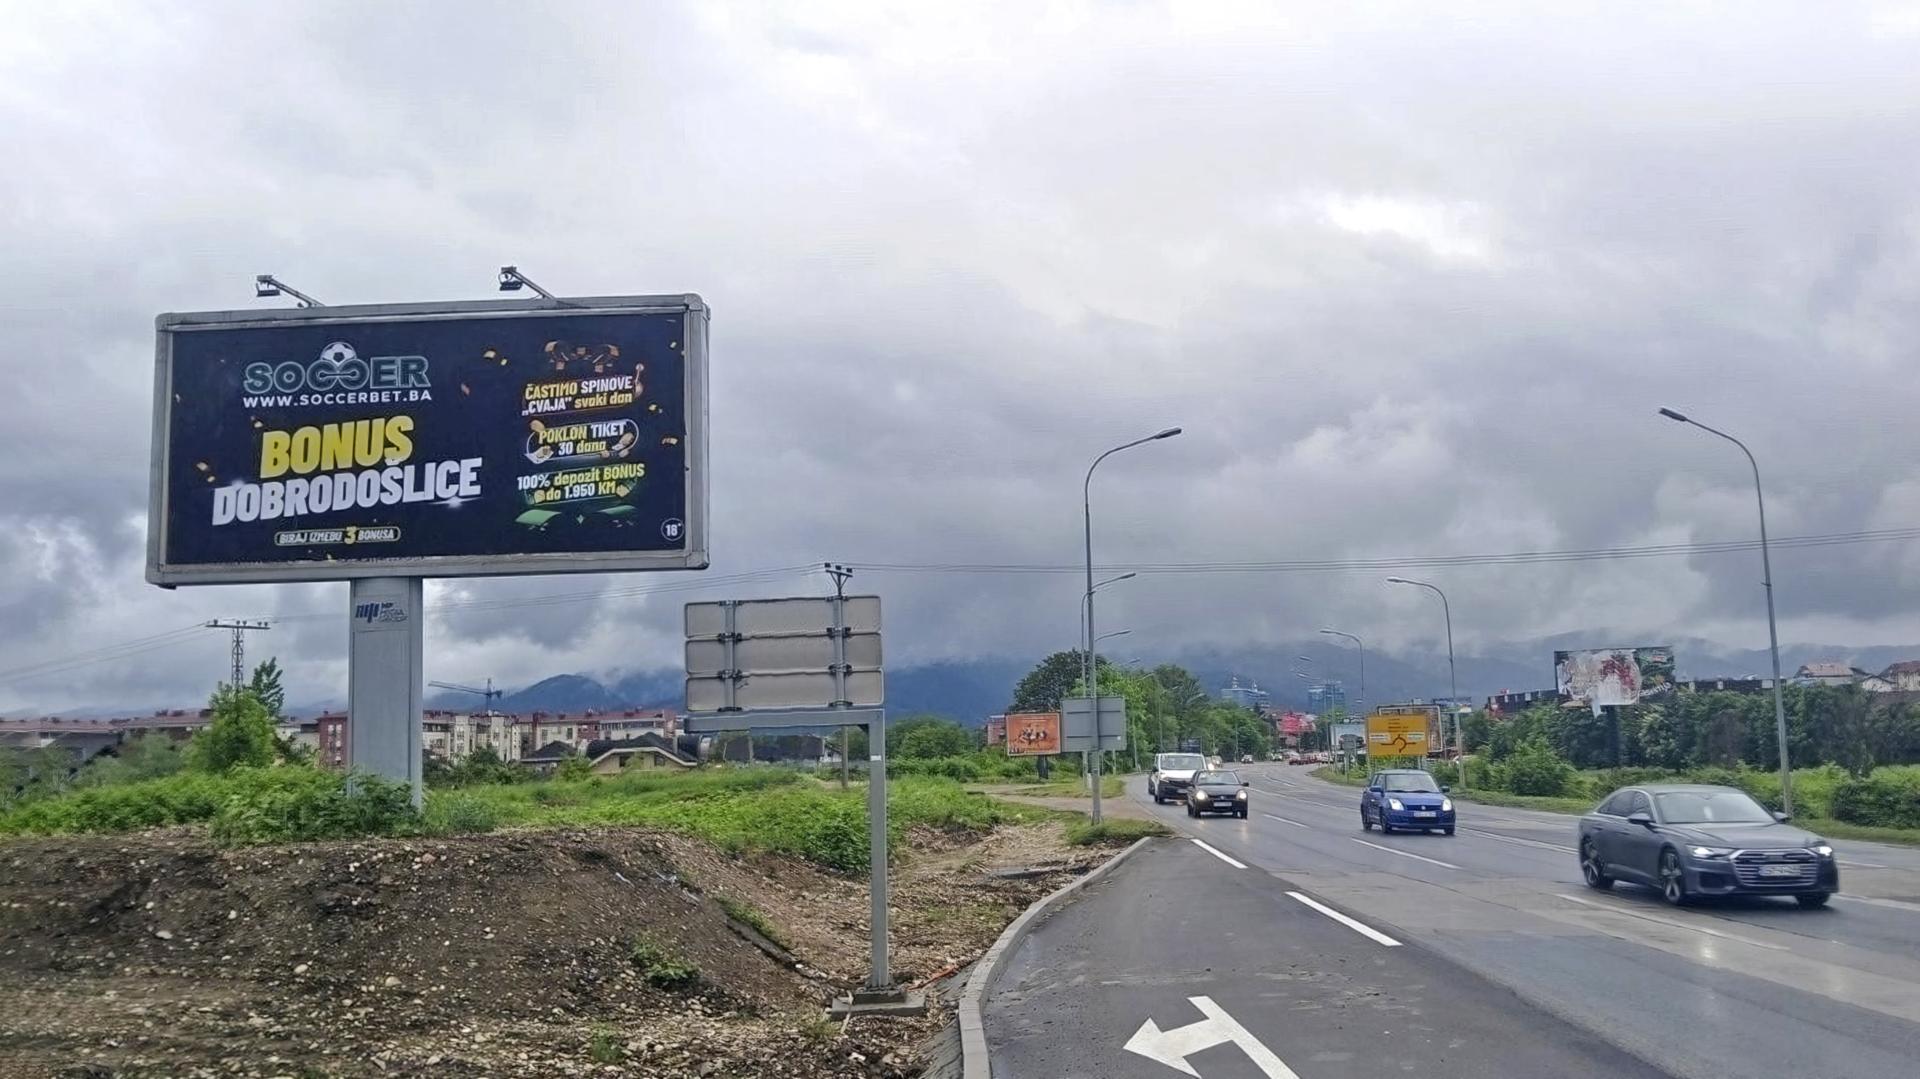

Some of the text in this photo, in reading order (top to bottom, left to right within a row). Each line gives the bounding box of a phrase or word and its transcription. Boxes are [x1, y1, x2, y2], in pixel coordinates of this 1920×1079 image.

[243, 356, 432, 394] SOCCER
[243, 390, 432, 408] WWW.SOCCERBET.BA
[525, 376, 633, 400] ČASTIMO SPINOVE
[574, 392, 607, 409] svaki
[609, 392, 633, 404] dan
[538, 422, 627, 444] POKLON TIKET
[260, 415, 414, 479] BONUS
[558, 440, 607, 455] 30 dana
[517, 463, 645, 491] 100% depozit BONUS
[211, 456, 483, 526] DOBRODOŠLICE
[546, 481, 617, 501] do 1.950 KM
[344, 526, 357, 544] 3
[358, 529, 394, 541] BONUSA
